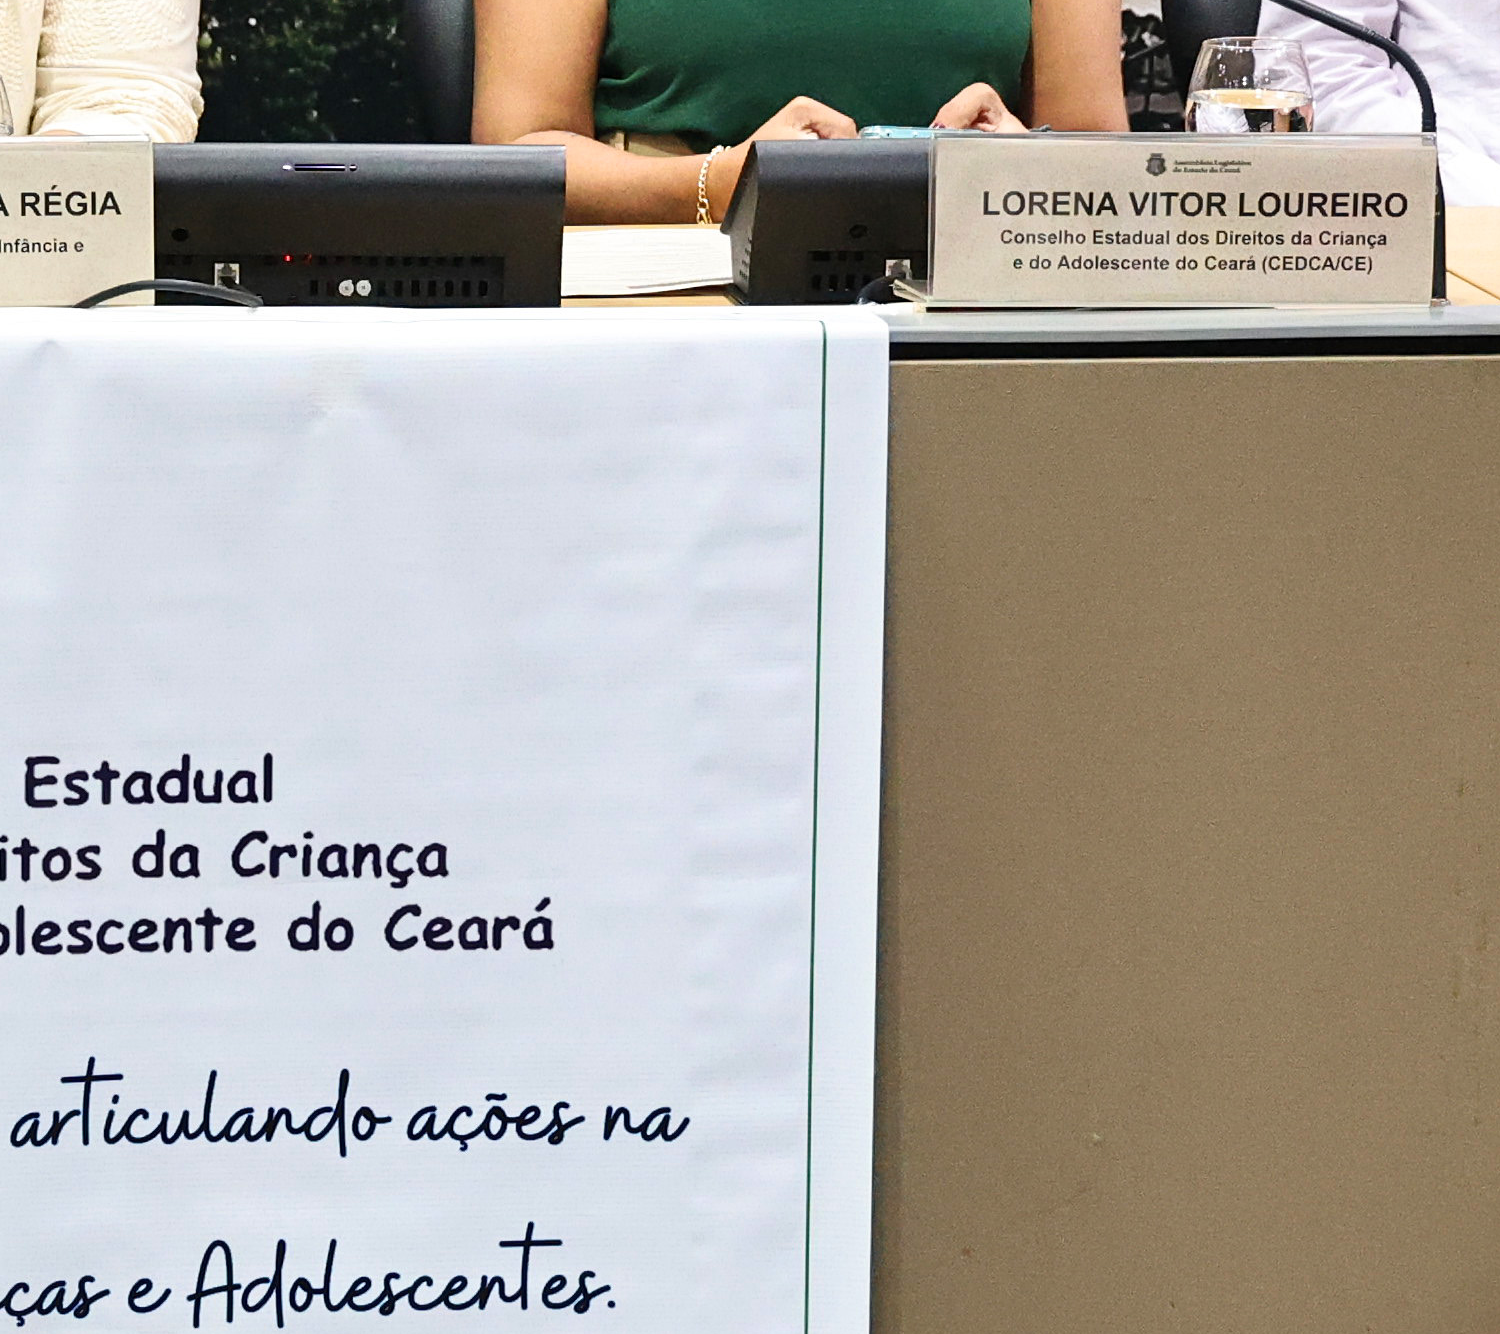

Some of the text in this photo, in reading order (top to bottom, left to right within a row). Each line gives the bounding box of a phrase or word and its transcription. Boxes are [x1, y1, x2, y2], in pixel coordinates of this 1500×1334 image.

[20, 184, 122, 217] RÉGIA
[983, 190, 1408, 218] LORENA VITOR LOUREIRO
[73, 241, 84, 253] e
[1000, 229, 1387, 250] Conselho Estadual dos Direitos da Criança
[1012, 254, 1373, 275] e do Adolescente do Ceará (CEDCA/CE)
[24, 752, 274, 809] Estadual
[131, 828, 201, 879] da
[230, 830, 449, 889] Criança
[287, 900, 355, 952] do
[383, 896, 555, 952] Ceará
[9, 1056, 393, 1158] articulando
[406, 1092, 586, 1152] ações
[603, 1105, 691, 1143] na
[127, 1277, 172, 1314] e
[186, 1221, 616, 1329] Adolescentes.
